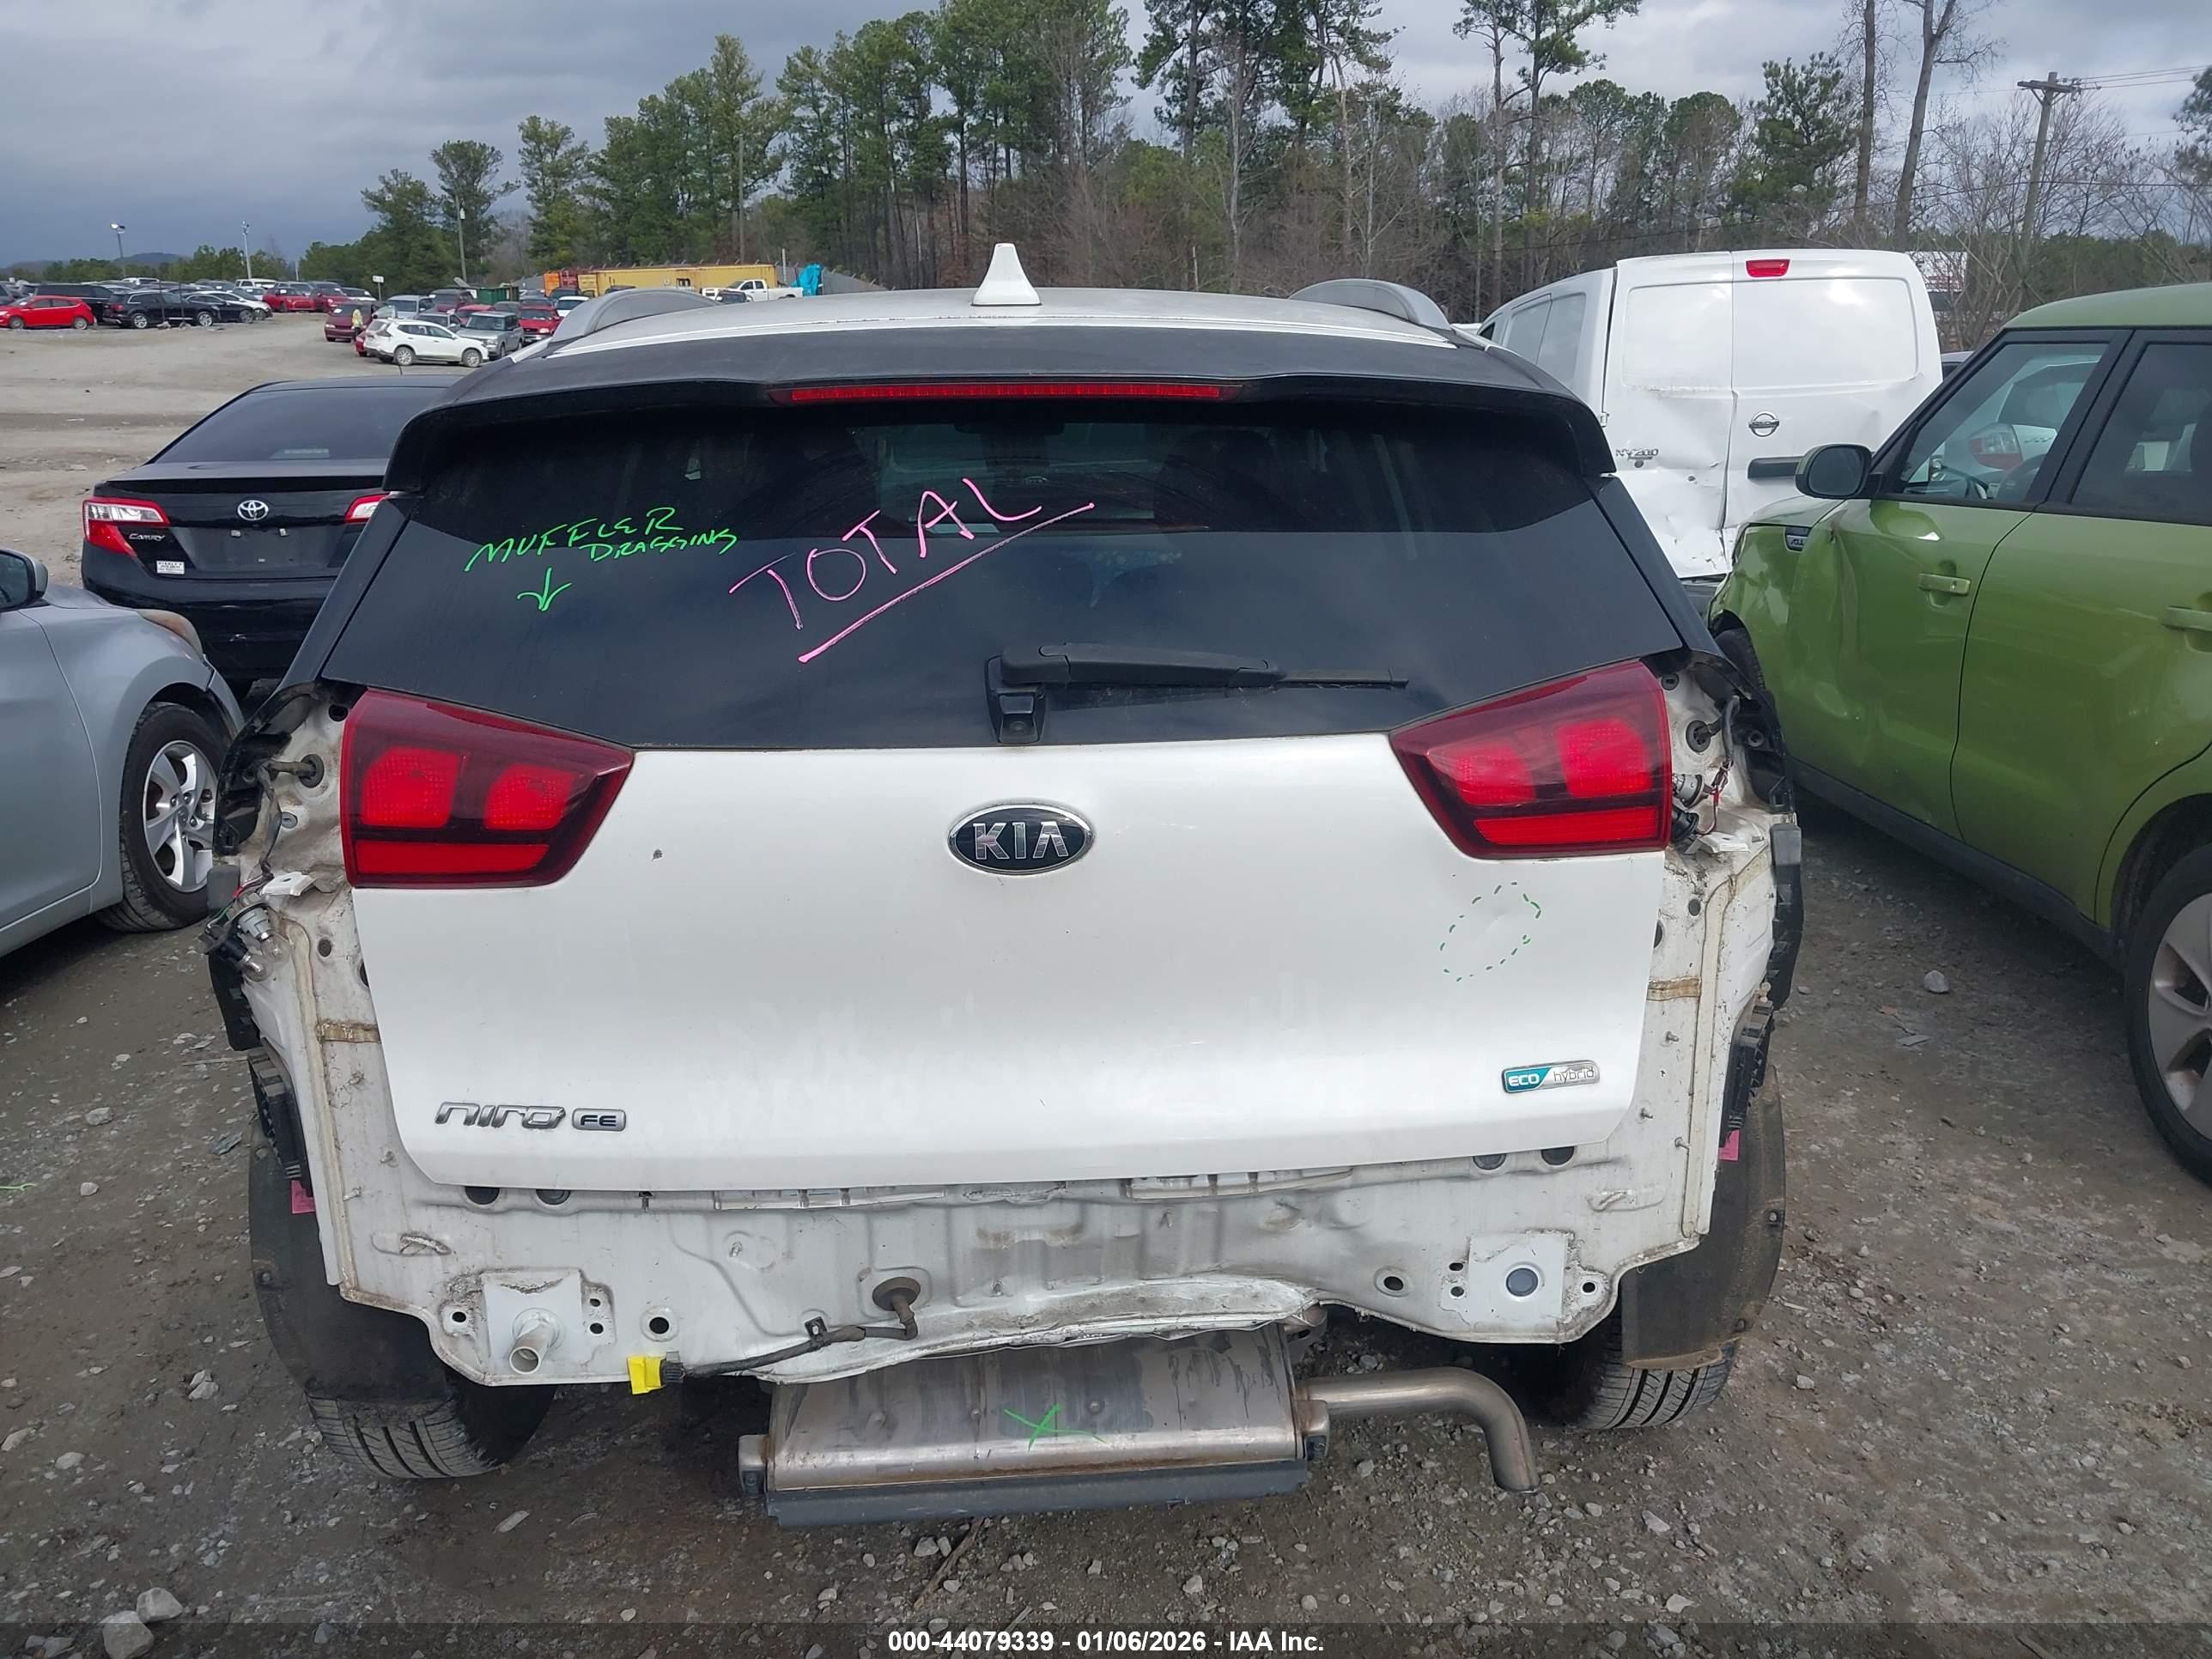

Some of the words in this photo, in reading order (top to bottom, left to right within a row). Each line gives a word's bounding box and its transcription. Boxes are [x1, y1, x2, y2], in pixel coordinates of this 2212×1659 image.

[463, 507, 684, 572] MUFFLER
[728, 478, 1042, 630] TOTAL
[972, 821, 1069, 860] KIA
[1508, 1073, 1540, 1087] ECO
[1553, 1066, 1595, 1084] hybrid
[580, 1115, 617, 1127] FE
